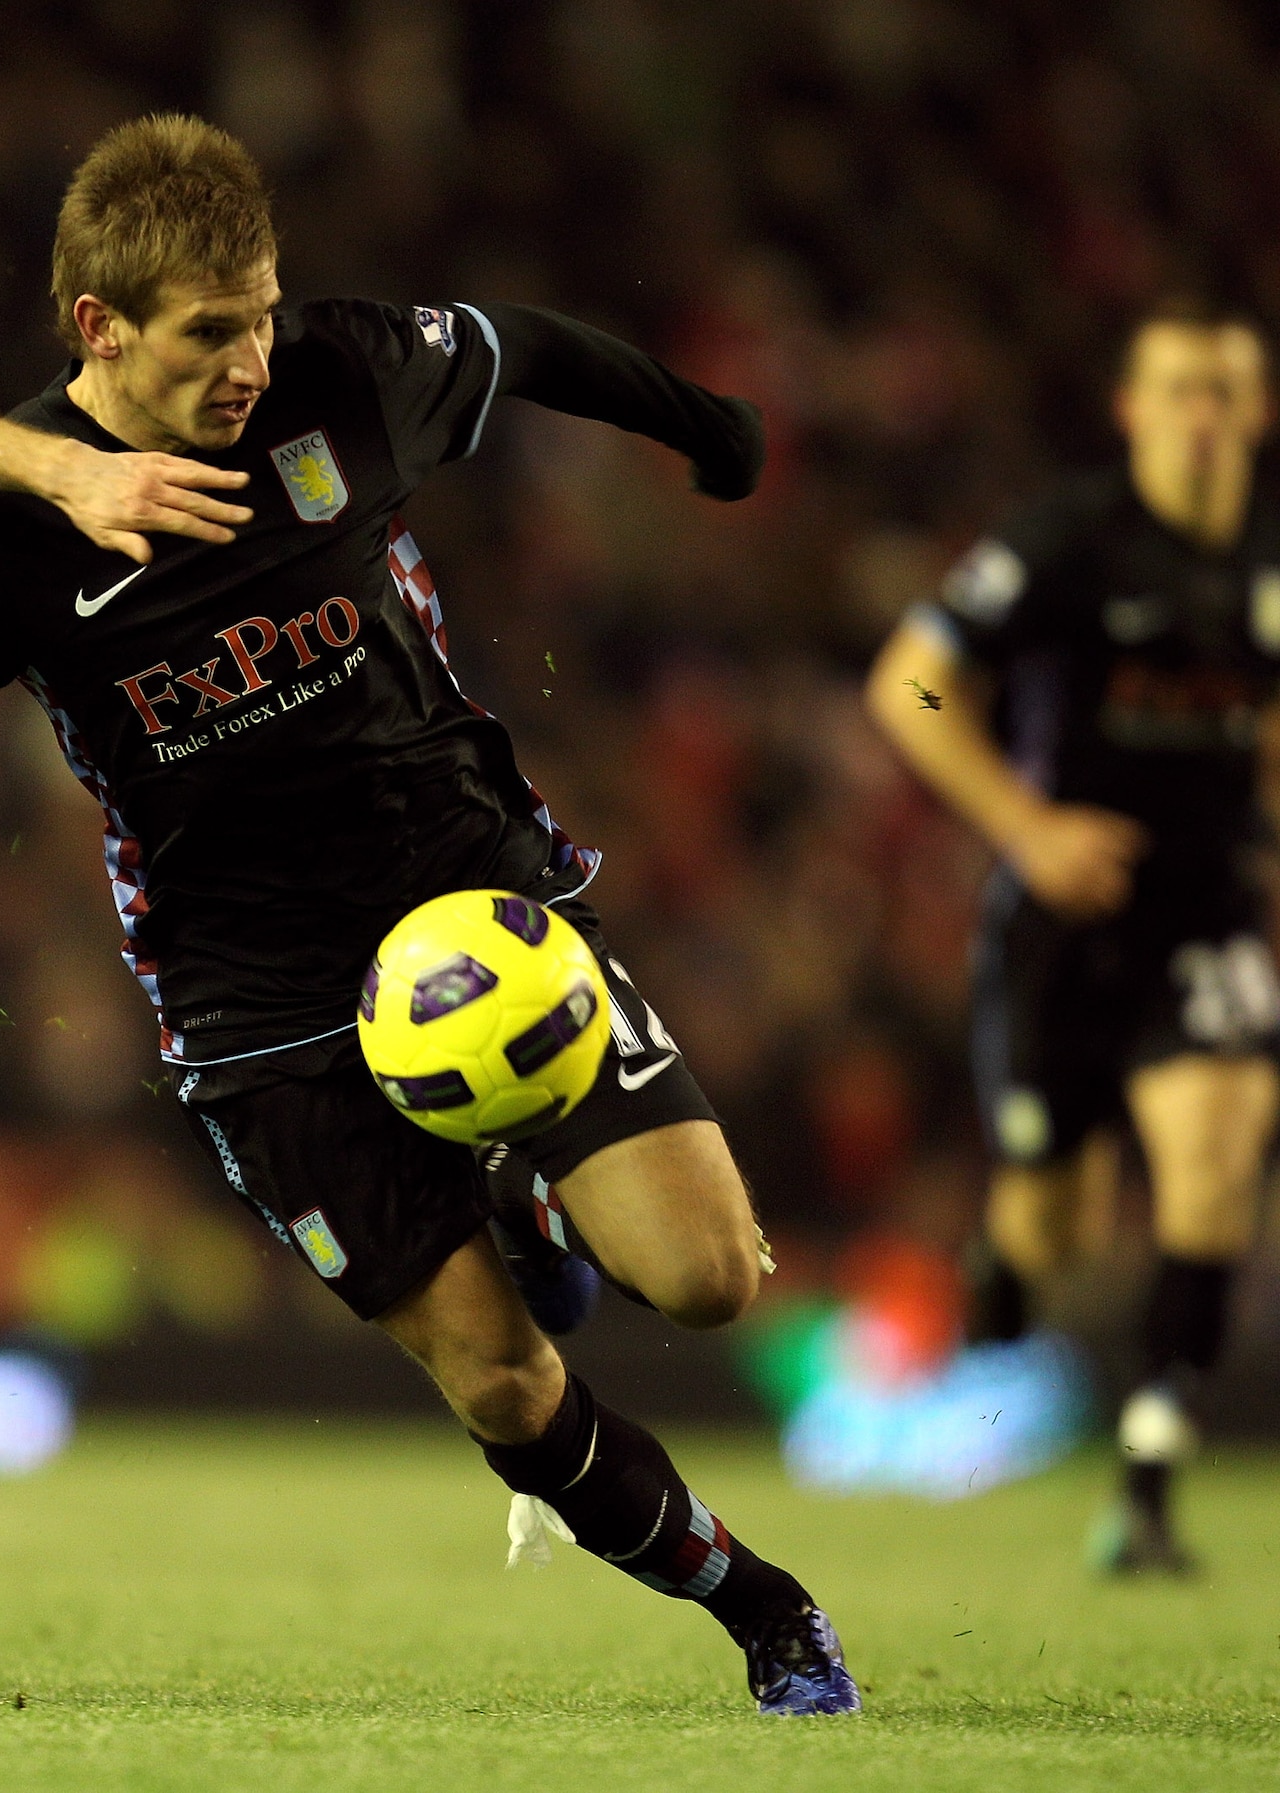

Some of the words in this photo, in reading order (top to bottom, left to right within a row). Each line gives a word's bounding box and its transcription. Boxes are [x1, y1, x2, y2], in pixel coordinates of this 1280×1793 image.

[279, 435, 324, 465] AVFC
[114, 596, 360, 735] FxPro
[152, 734, 210, 763] Trade
[213, 703, 276, 741] Forex
[277, 679, 326, 712] Like
[329, 671, 343, 687] a
[343, 646, 366, 678] Pro
[183, 1010, 223, 1029] DRI-FIT
[297, 1213, 321, 1236] AVFC
